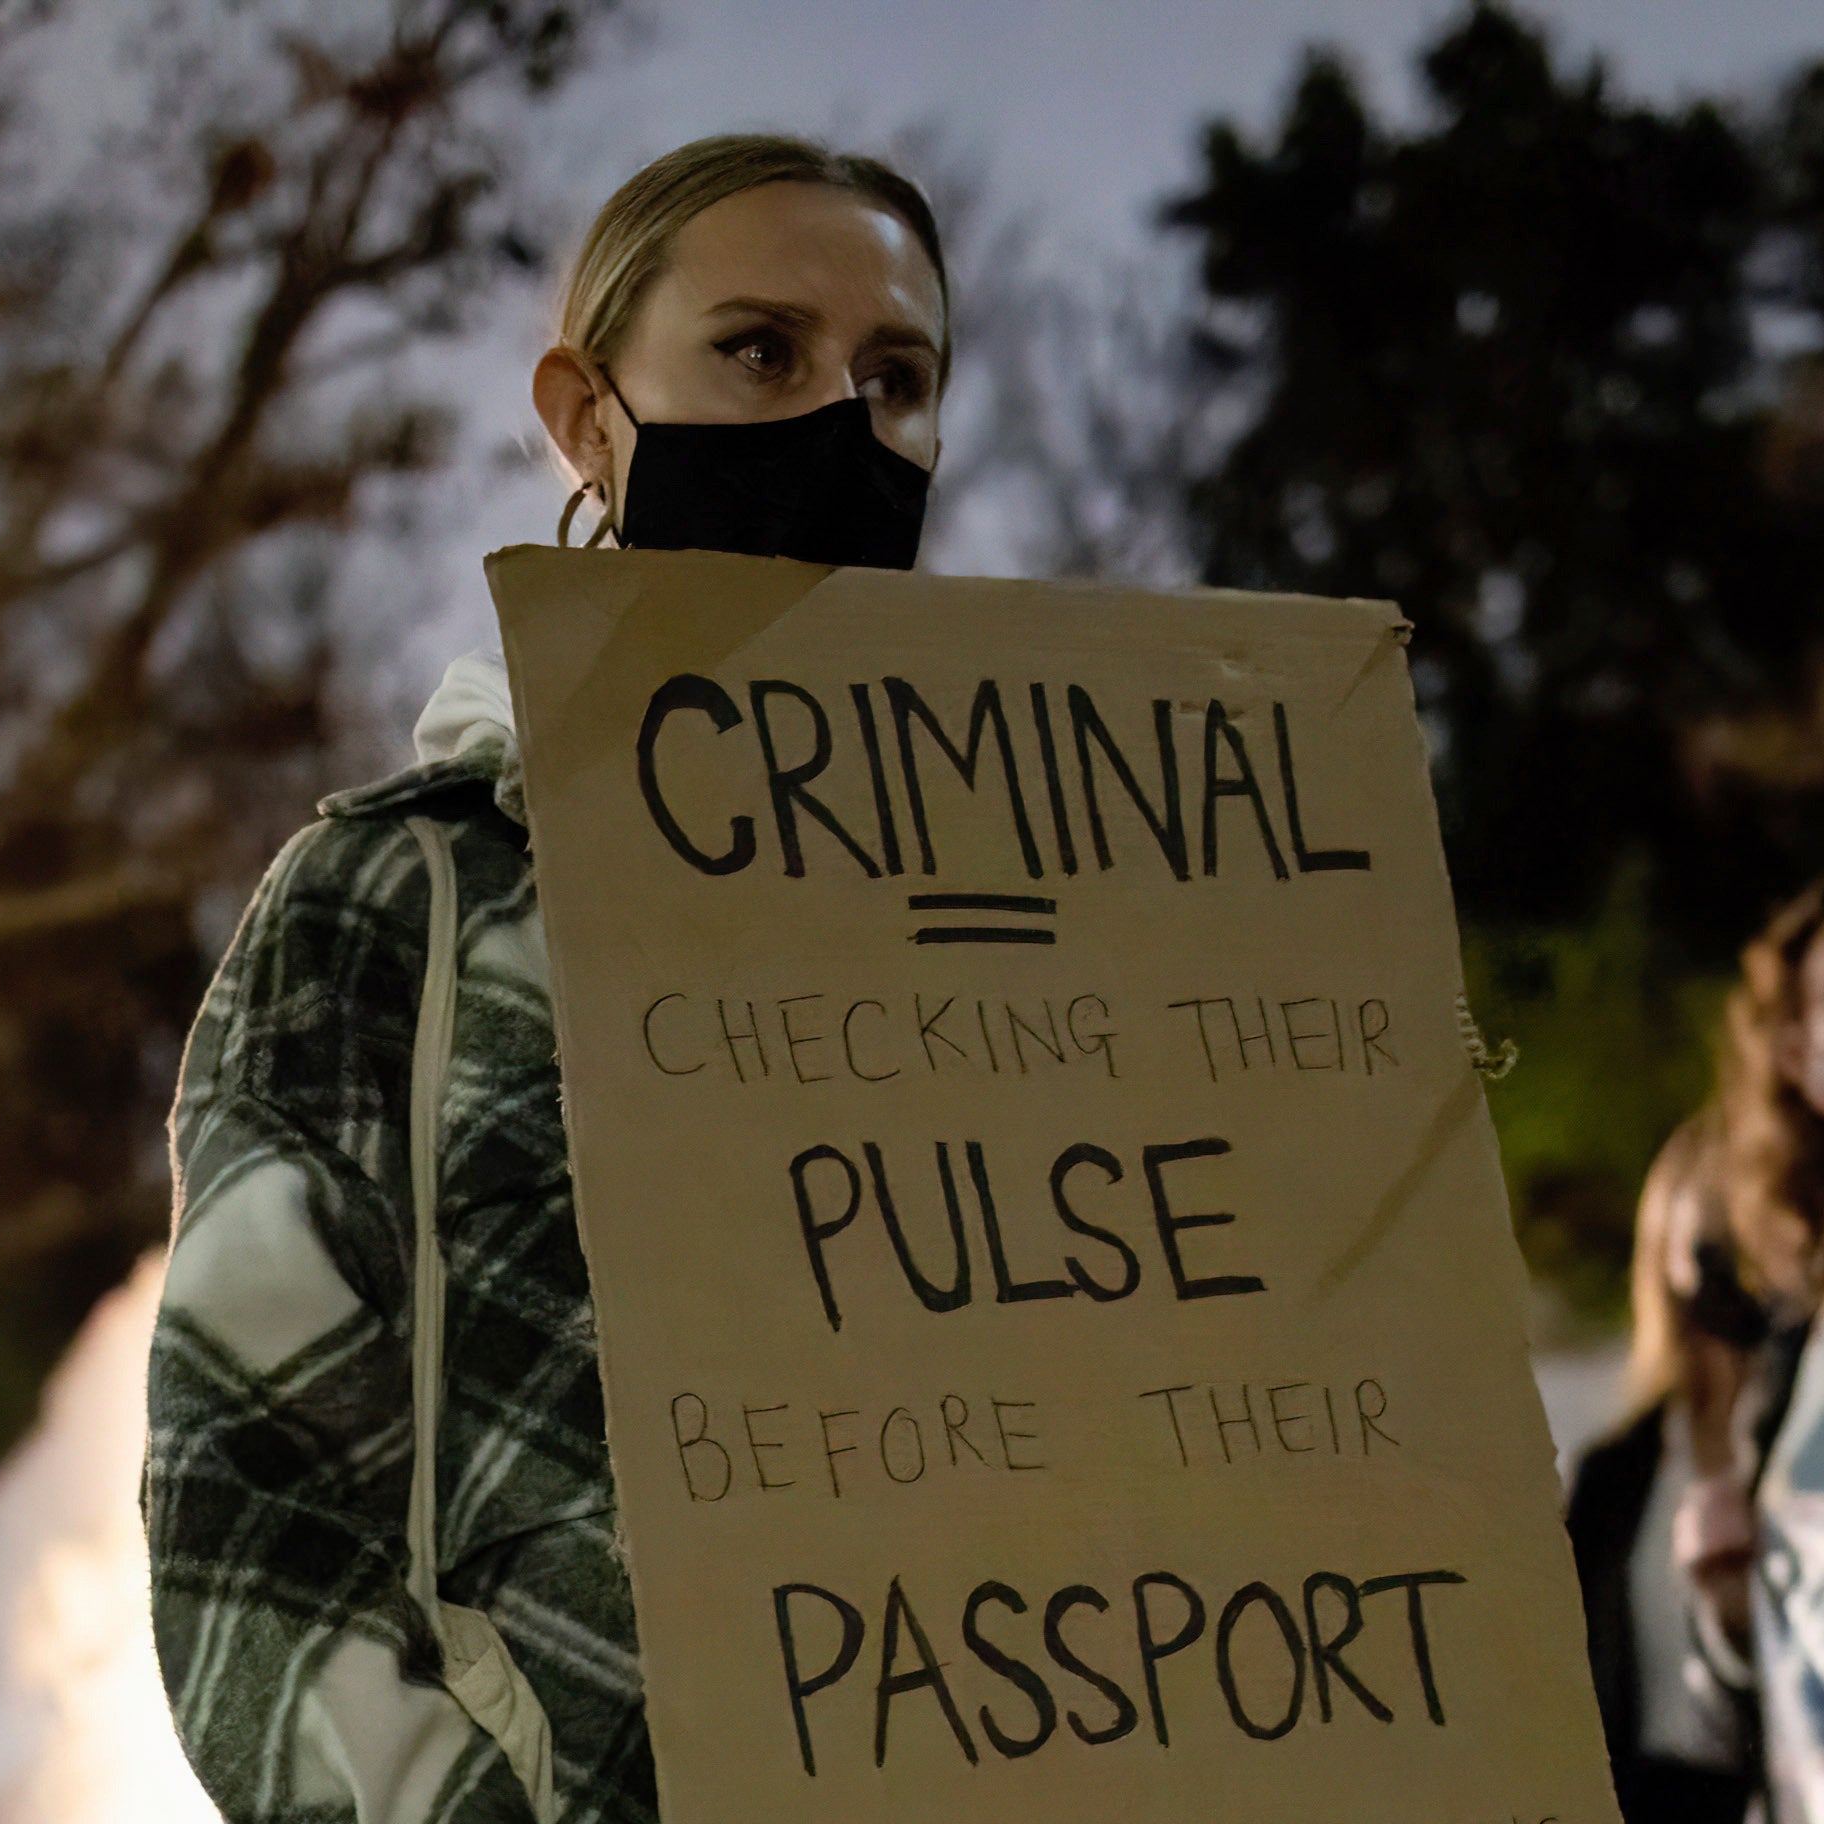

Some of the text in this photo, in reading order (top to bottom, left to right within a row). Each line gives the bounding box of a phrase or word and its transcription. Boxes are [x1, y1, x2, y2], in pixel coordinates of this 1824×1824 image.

[635, 672, 1372, 880] CRIMINAL
[641, 992, 1401, 1084] CHECKING THEIR
[788, 1136, 1268, 1333] PULSE
[670, 1378, 1402, 1503] BEFORE THEIR
[773, 1569, 1468, 1778] PASSPORT
